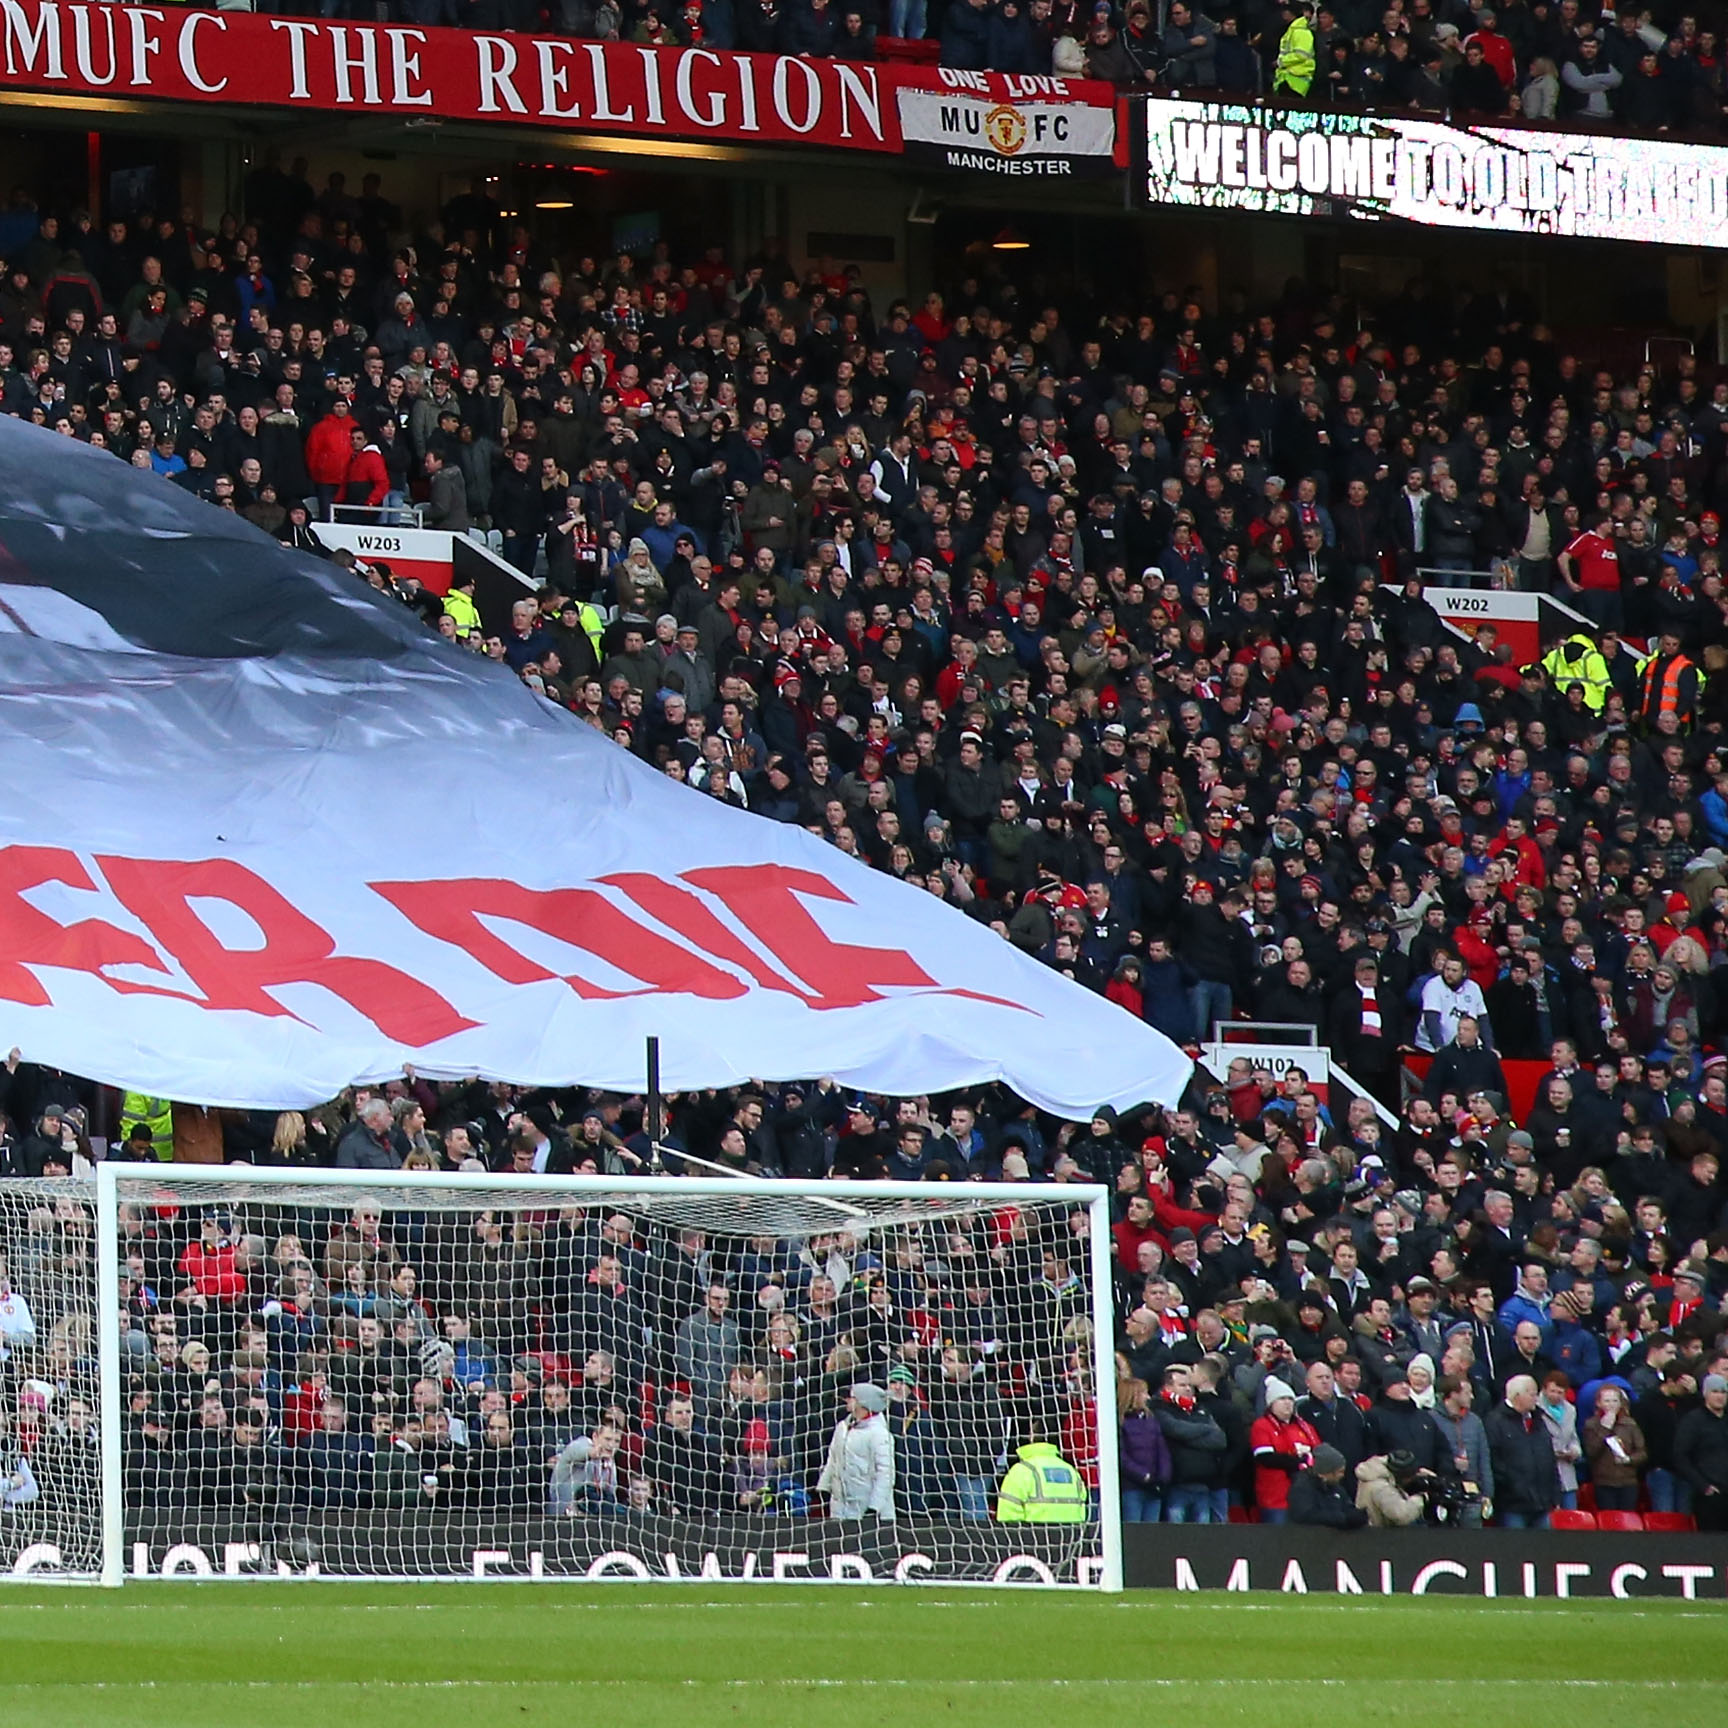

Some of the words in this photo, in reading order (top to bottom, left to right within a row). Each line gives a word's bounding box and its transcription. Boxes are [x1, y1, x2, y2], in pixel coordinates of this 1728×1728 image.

[270, 19, 433, 106] THE
[474, 36, 884, 142] RELIGION
[938, 67, 991, 93] ONE
[1003, 73, 1070, 98] LOVE
[947, 152, 1071, 174] MANCHESTER
[1172, 120, 1398, 202] WELCOME
[1404, 138, 1463, 206] TO
[1473, 144, 1558, 210] OLD
[357, 535, 401, 551] W203
[1447, 597, 1488, 612] W202
[364, 863, 1044, 1011] DIE
